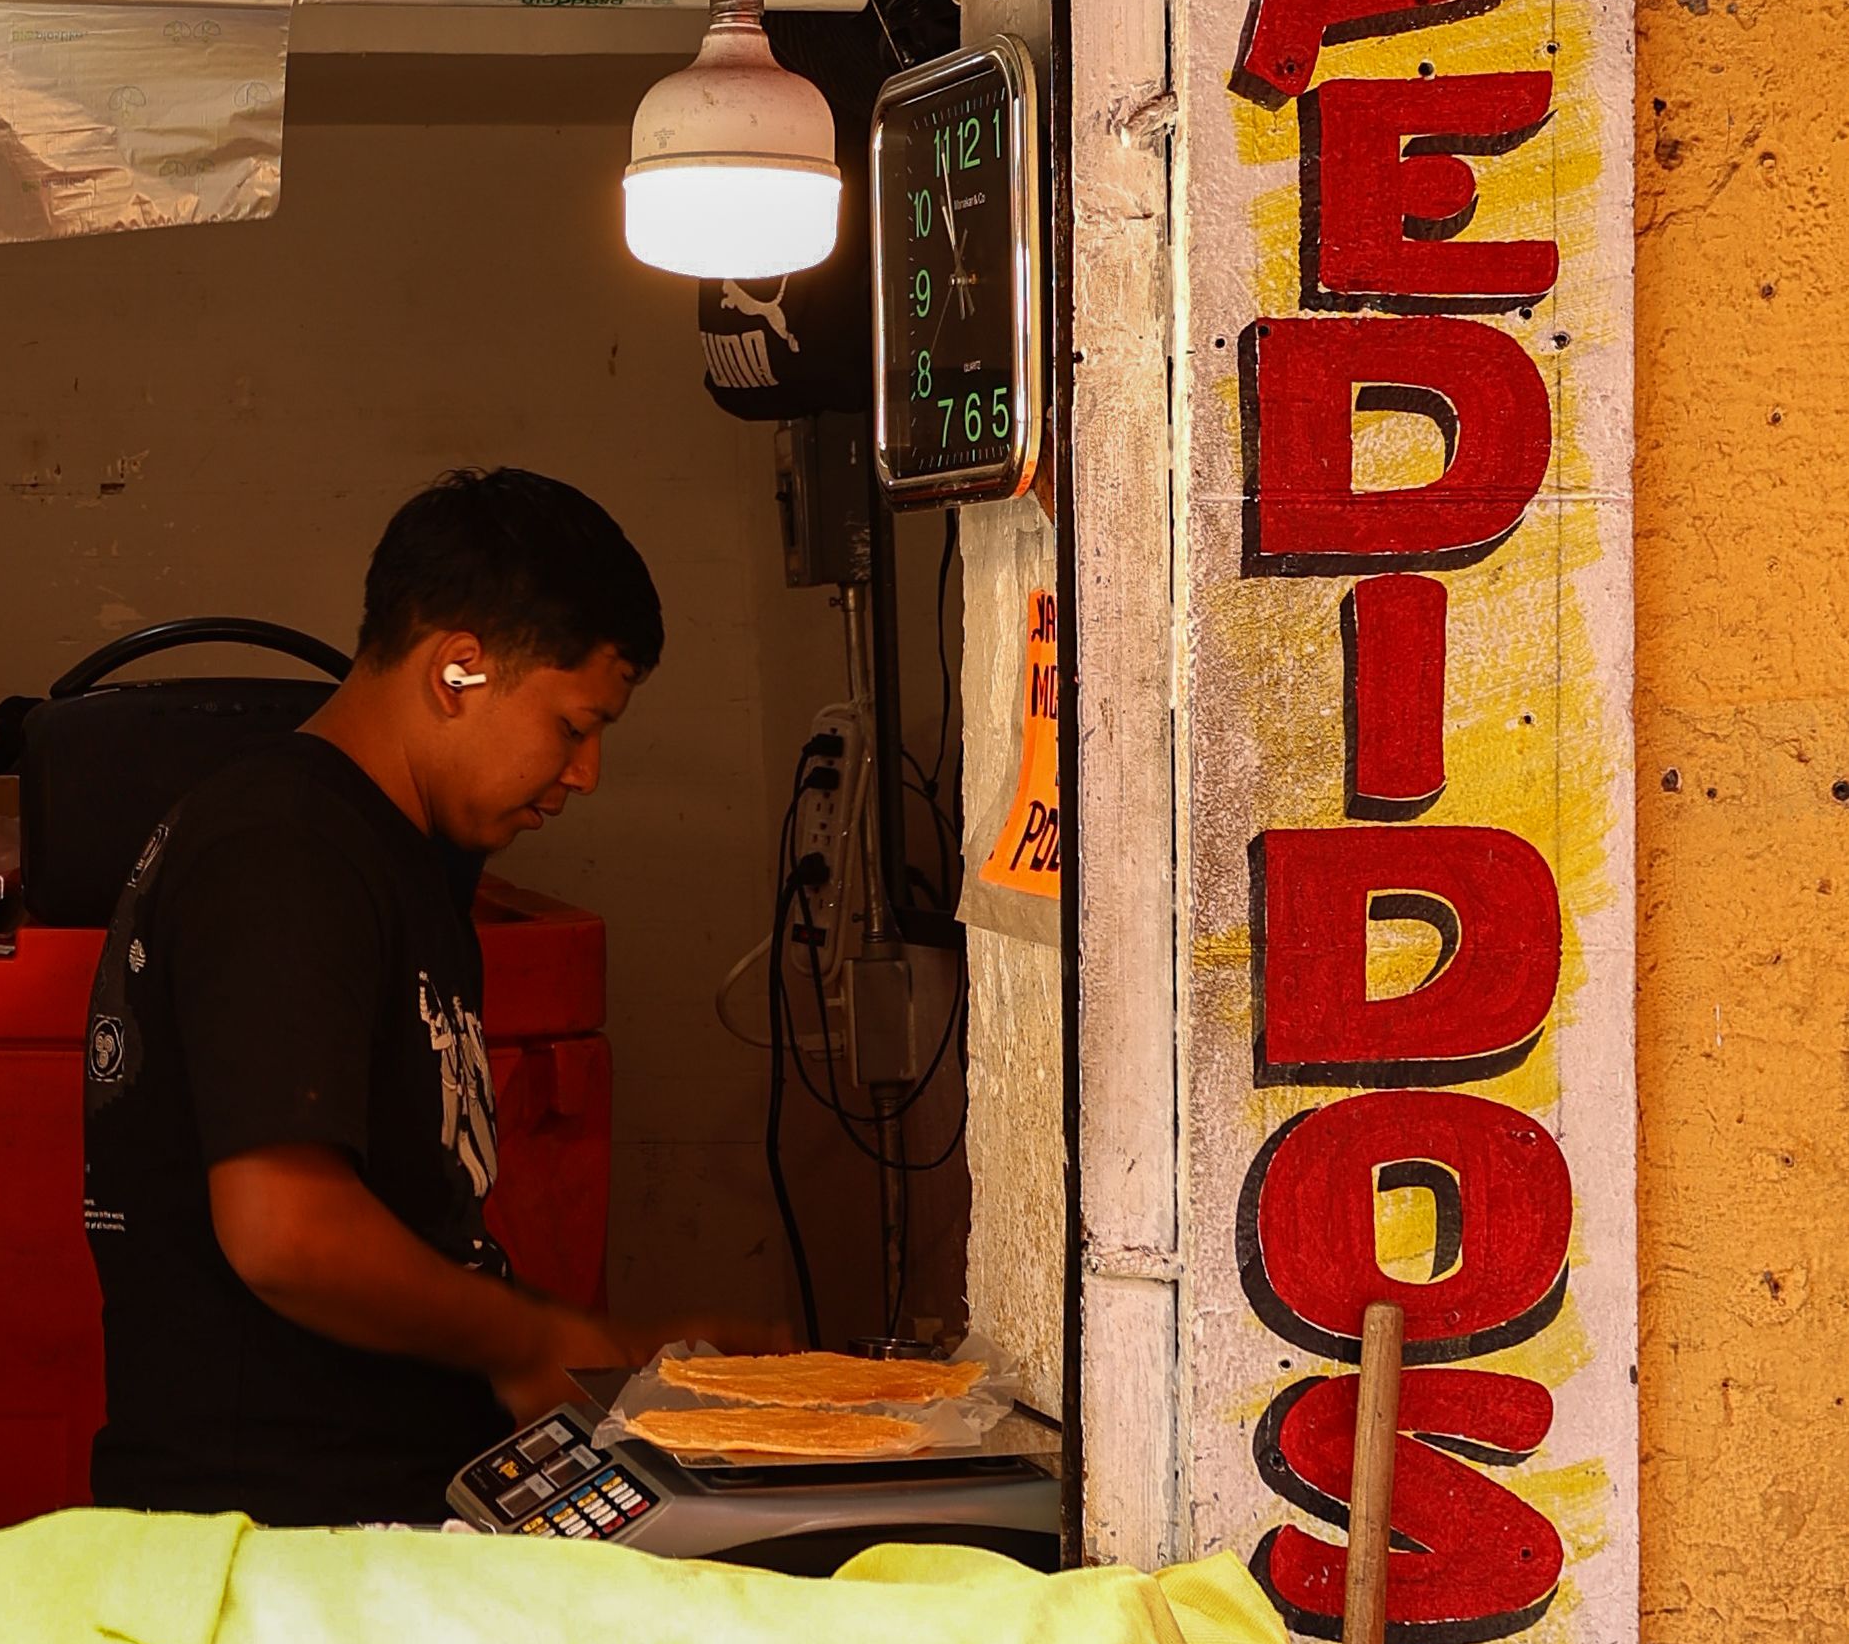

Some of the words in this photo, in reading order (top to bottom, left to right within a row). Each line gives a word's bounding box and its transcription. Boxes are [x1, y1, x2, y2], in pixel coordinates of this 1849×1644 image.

[933, 125, 950, 177] 11
[957, 117, 981, 170] 12
[992, 108, 1001, 159] 1
[914, 189, 932, 238] 10
[915, 268, 932, 318] 9
[917, 349, 932, 399] 8
[937, 398, 954, 449] 7
[964, 392, 982, 442] 6
[992, 387, 1010, 438] 5
